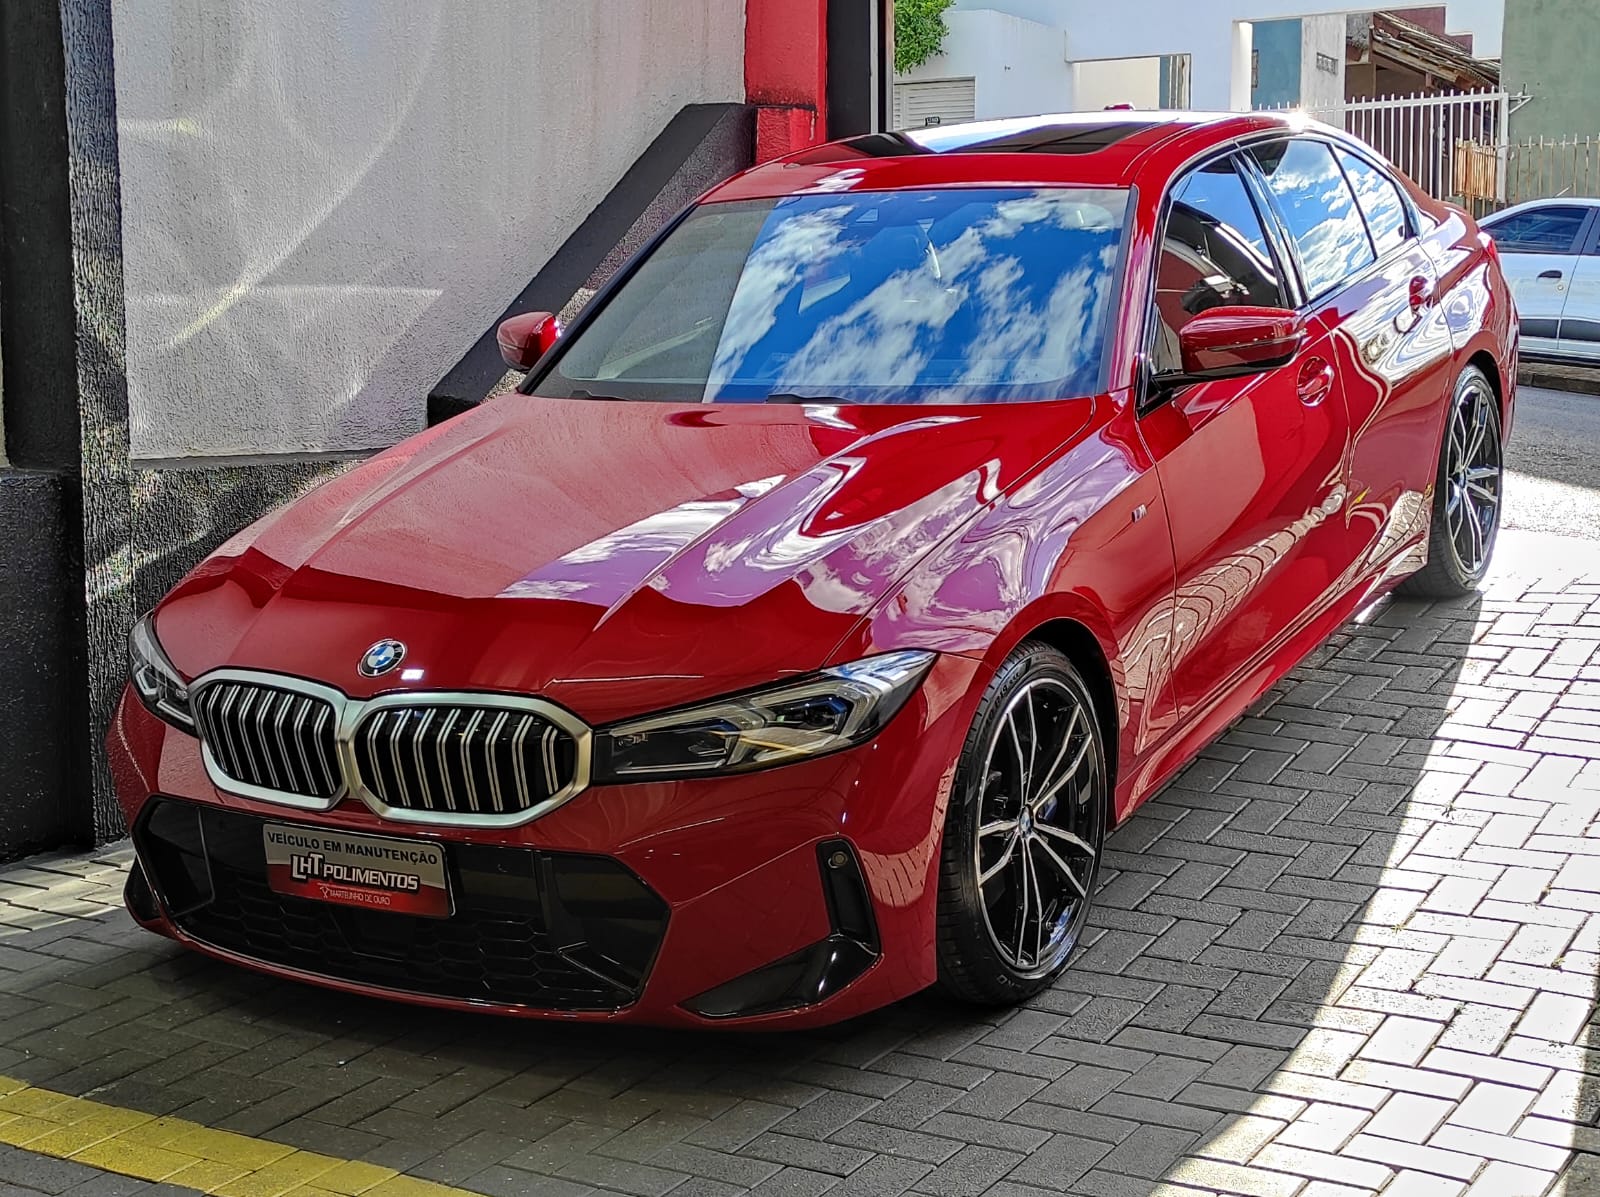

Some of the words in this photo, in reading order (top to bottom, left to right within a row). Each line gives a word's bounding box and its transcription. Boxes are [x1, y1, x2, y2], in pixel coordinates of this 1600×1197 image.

[268, 832, 320, 849] VEÍCULO
[324, 840, 342, 852] EM
[345, 843, 437, 865] MANUTENÇÃO
[292, 853, 323, 879] LHT
[323, 863, 418, 890] POLIMENTOS
